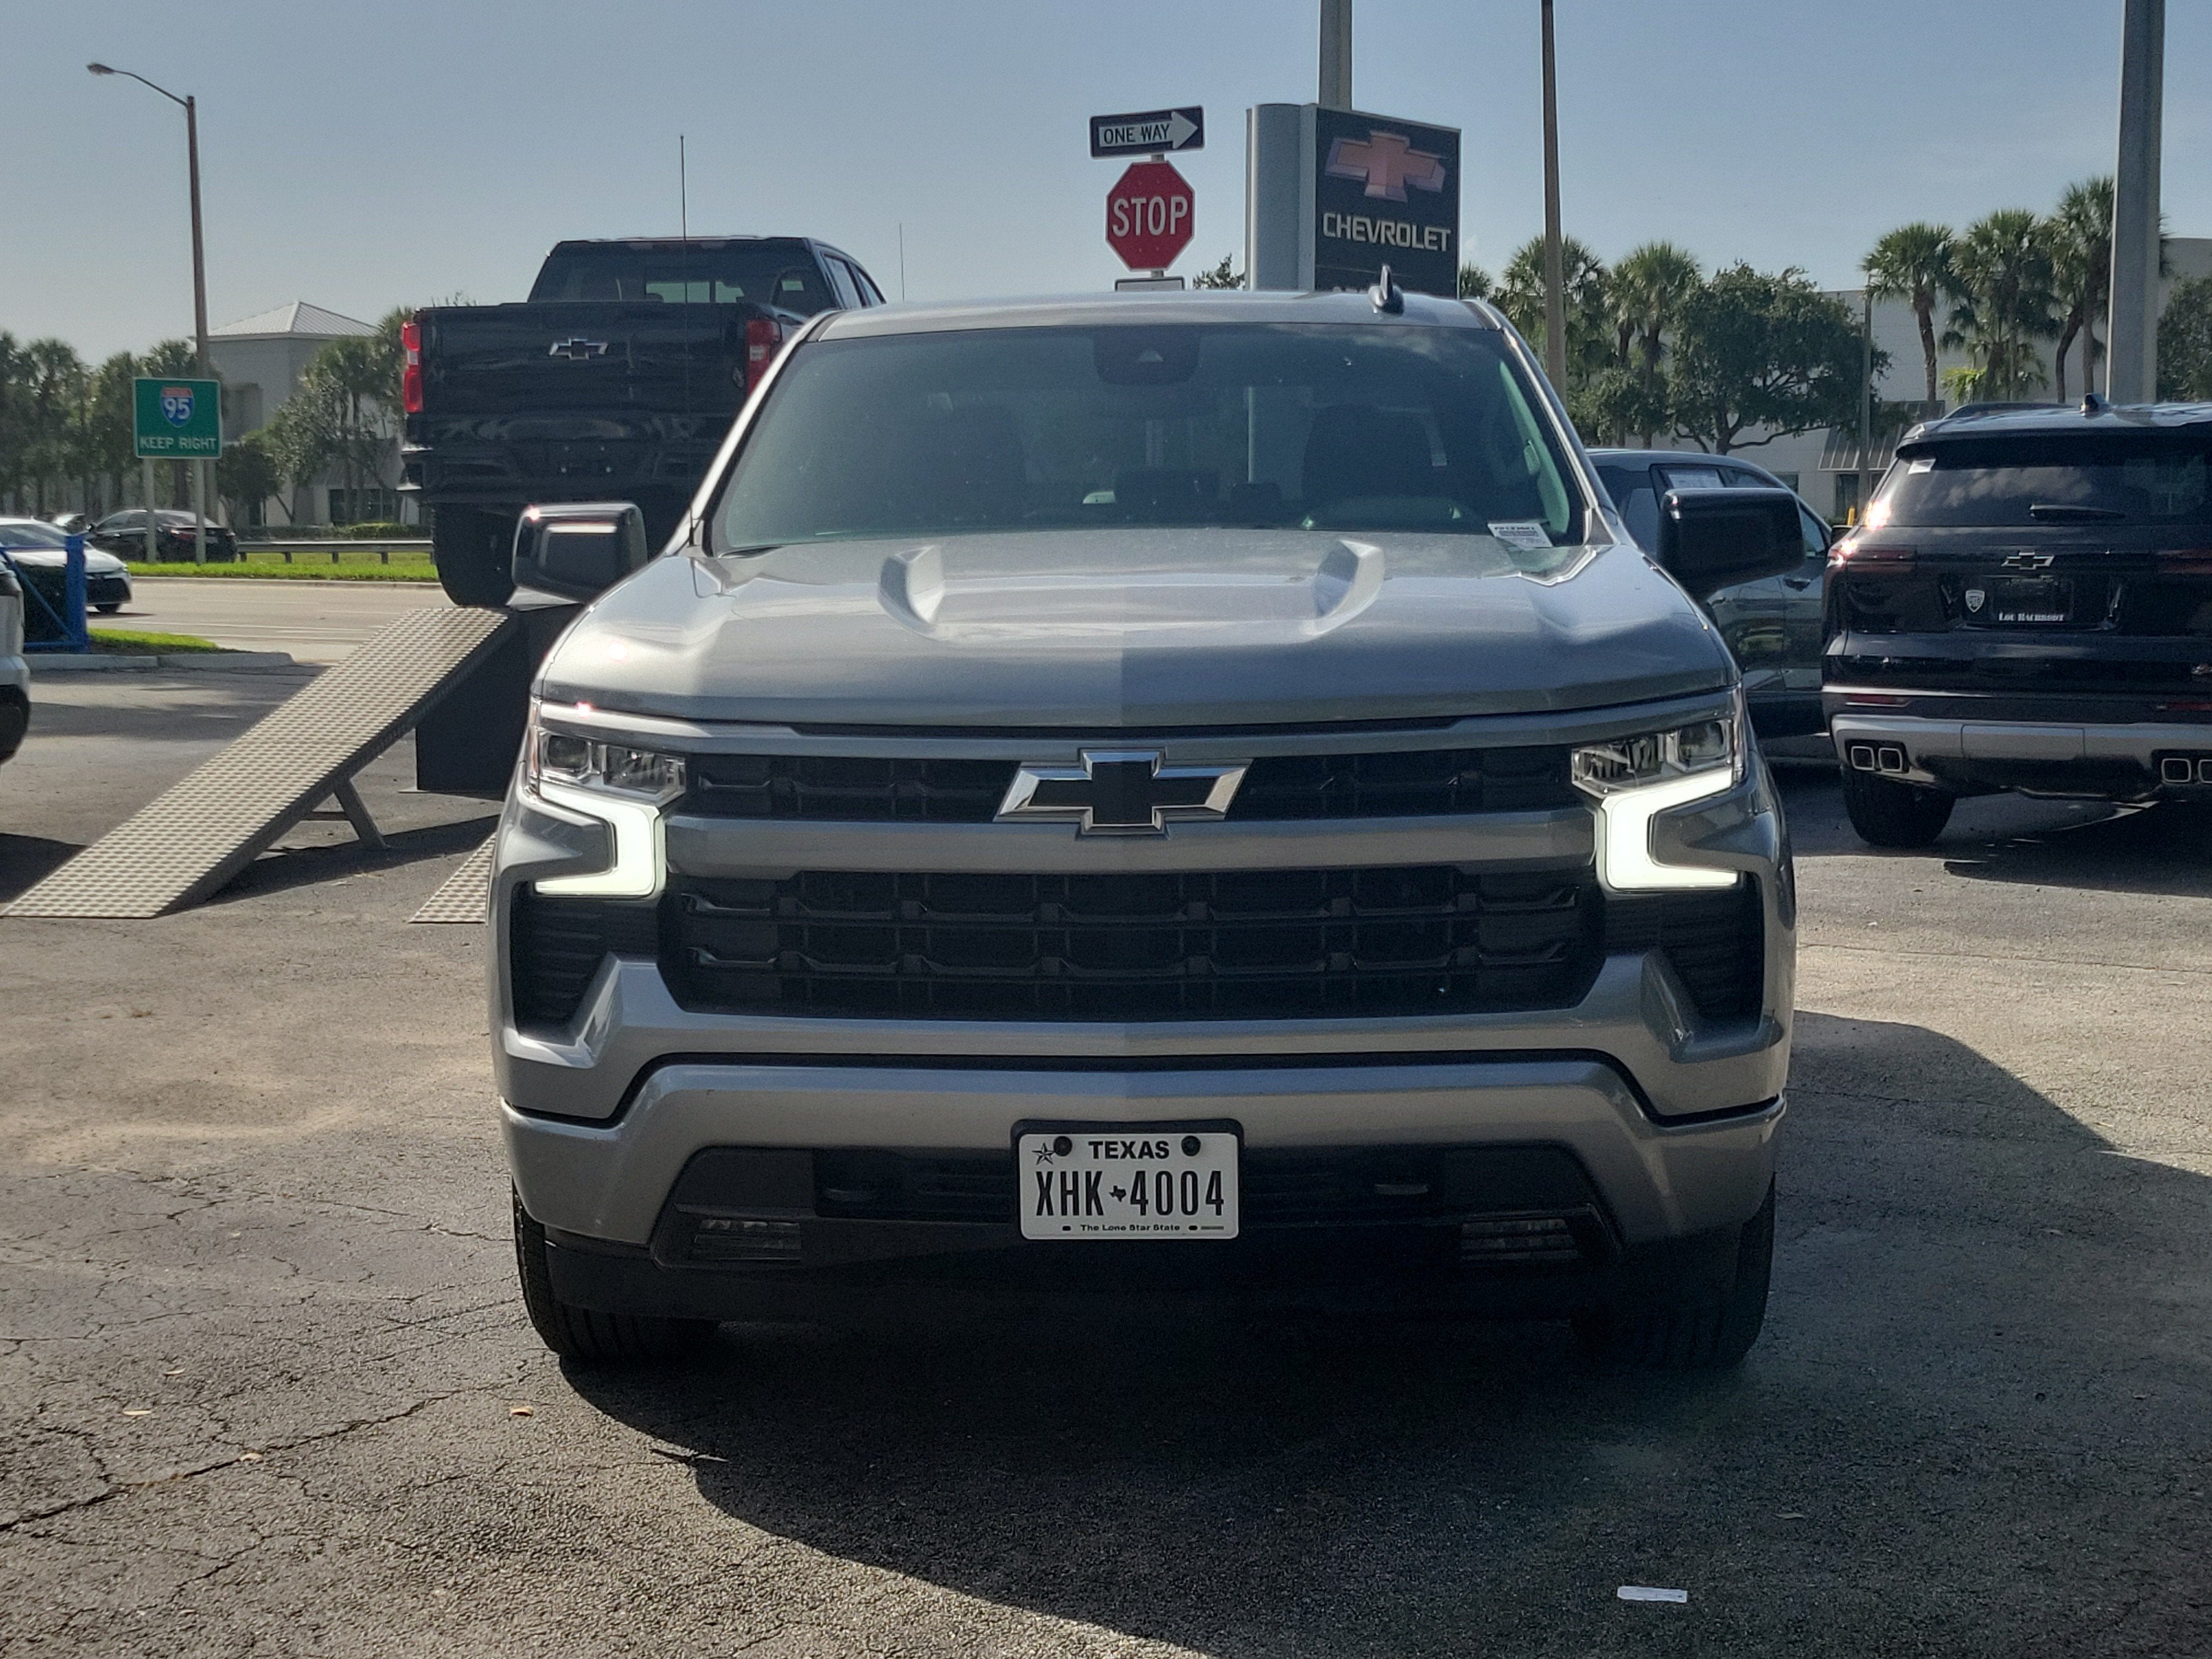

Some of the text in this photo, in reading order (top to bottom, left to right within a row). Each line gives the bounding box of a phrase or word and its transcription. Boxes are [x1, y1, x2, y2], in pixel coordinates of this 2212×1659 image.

[1103, 124, 1171, 144] ONE WAY
[1111, 195, 1189, 238] STOP
[1322, 211, 1452, 252] CHEVROLET
[164, 398, 191, 419] 95
[139, 436, 217, 450] KEEP RIGHT
[1088, 1140, 1170, 1159] TEXAS
[1035, 1170, 1224, 1216] XHK 4004
